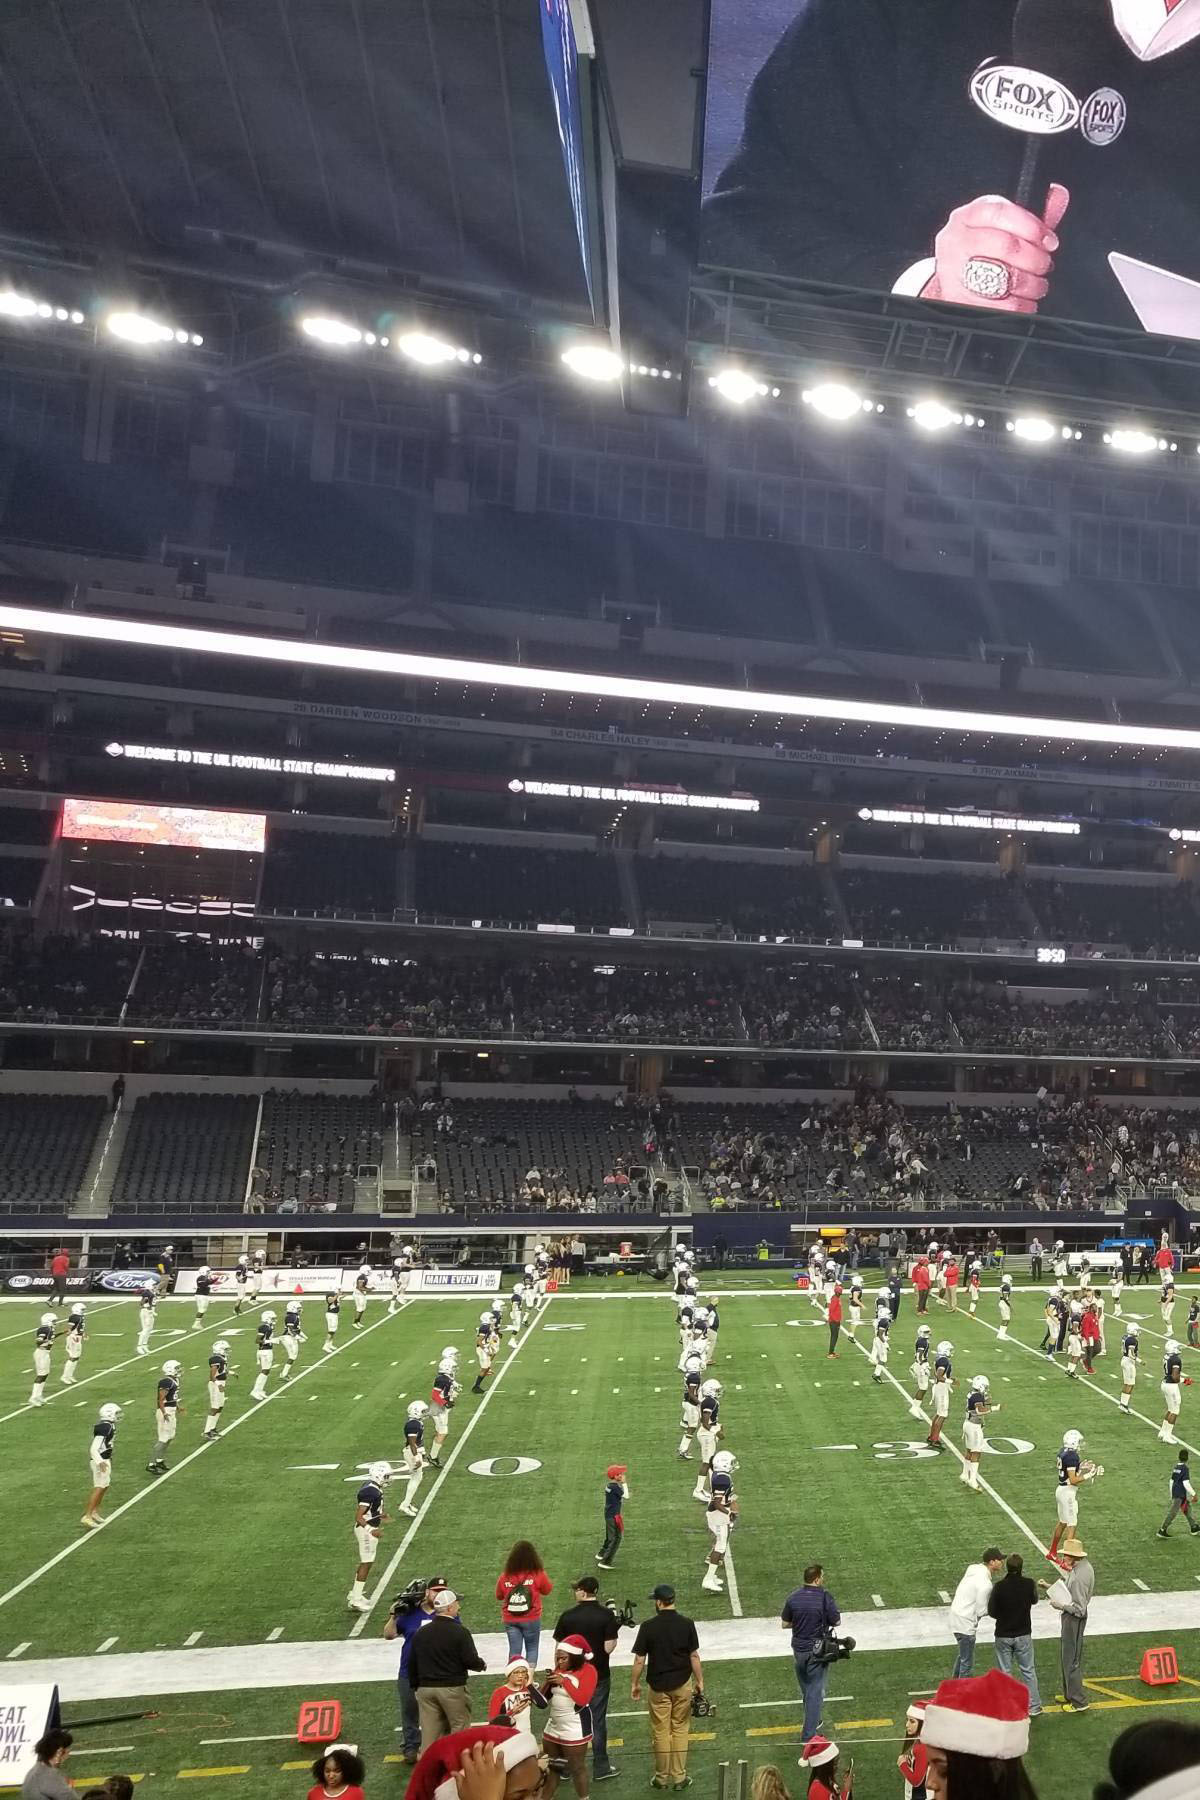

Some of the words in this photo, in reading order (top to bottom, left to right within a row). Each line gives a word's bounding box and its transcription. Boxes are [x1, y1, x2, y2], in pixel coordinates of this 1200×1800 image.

[995, 75, 1057, 113] FOX
[992, 98, 1055, 123] SPORTS
[1091, 100, 1118, 124] FOX
[310, 705, 358, 718] DARREN
[363, 710, 422, 724] WOODSON
[617, 735, 650, 745] HALEY
[124, 745, 177, 761] WELCOME
[177, 749, 191, 762] TO
[192, 751, 212, 765] THE
[232, 755, 281, 771] FOOTBALL
[283, 760, 313, 774] STATE
[525, 781, 570, 797] WELCOME
[570, 785, 582, 798] TO
[583, 786, 601, 799] THE
[616, 789, 661, 804] FOOTBALL
[661, 792, 688, 806] STATE
[425, 1275, 446, 1284] MAIN
[450, 1275, 478, 1284] EVENT
[546, 1281, 558, 1290] 20
[872, 1437, 1036, 1459] 30
[344, 1456, 543, 1481] 20
[1149, 1652, 1176, 1680] 30
[302, 1706, 334, 1737] 20
